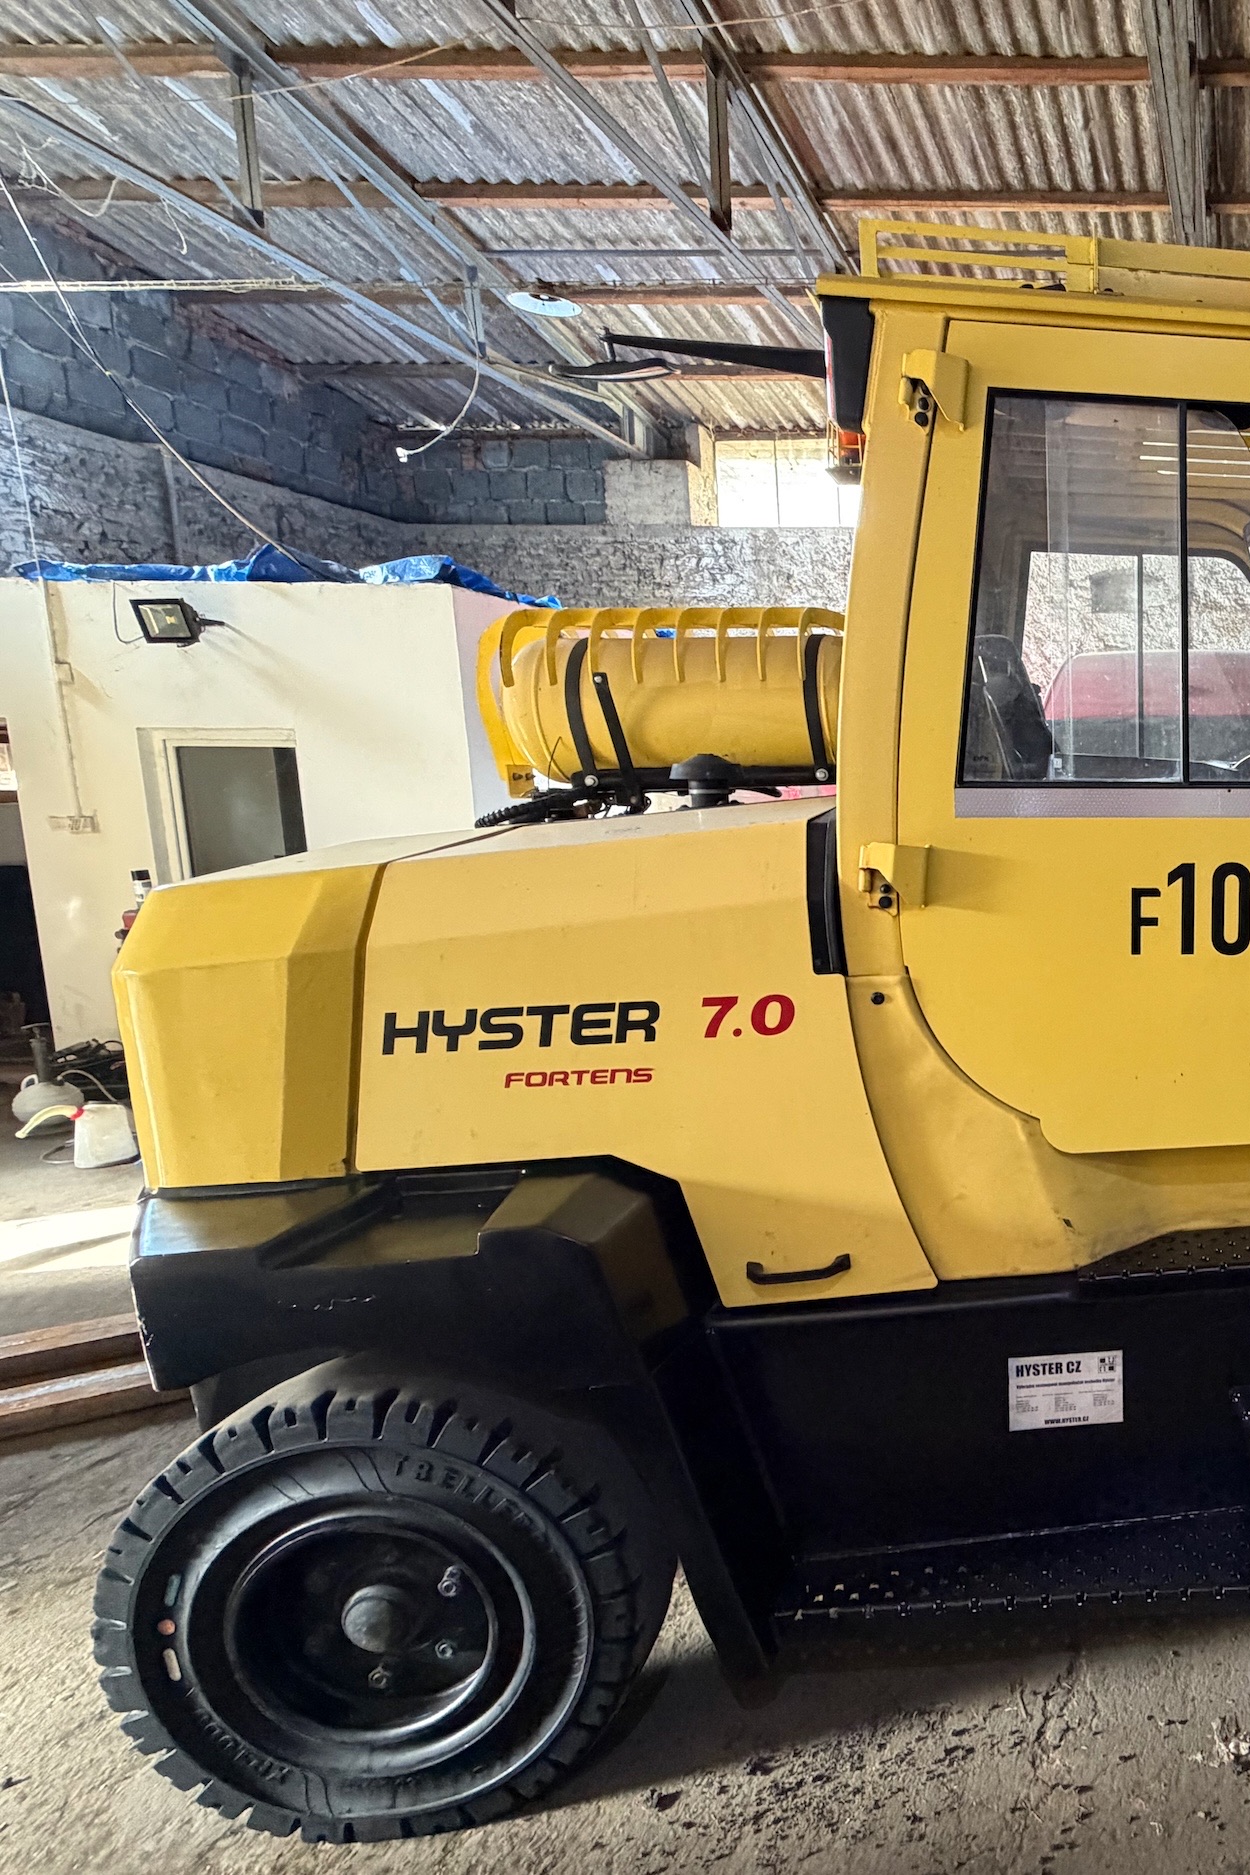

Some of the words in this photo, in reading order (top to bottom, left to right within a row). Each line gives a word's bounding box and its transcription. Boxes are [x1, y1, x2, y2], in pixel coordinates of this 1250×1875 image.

[383, 1000, 660, 1056] HYSTER
[702, 994, 795, 1039] 7.0
[504, 1067, 654, 1089] FORTENS
[1015, 1361, 1063, 1377] HYSTER
[1066, 1360, 1082, 1374] CZ
